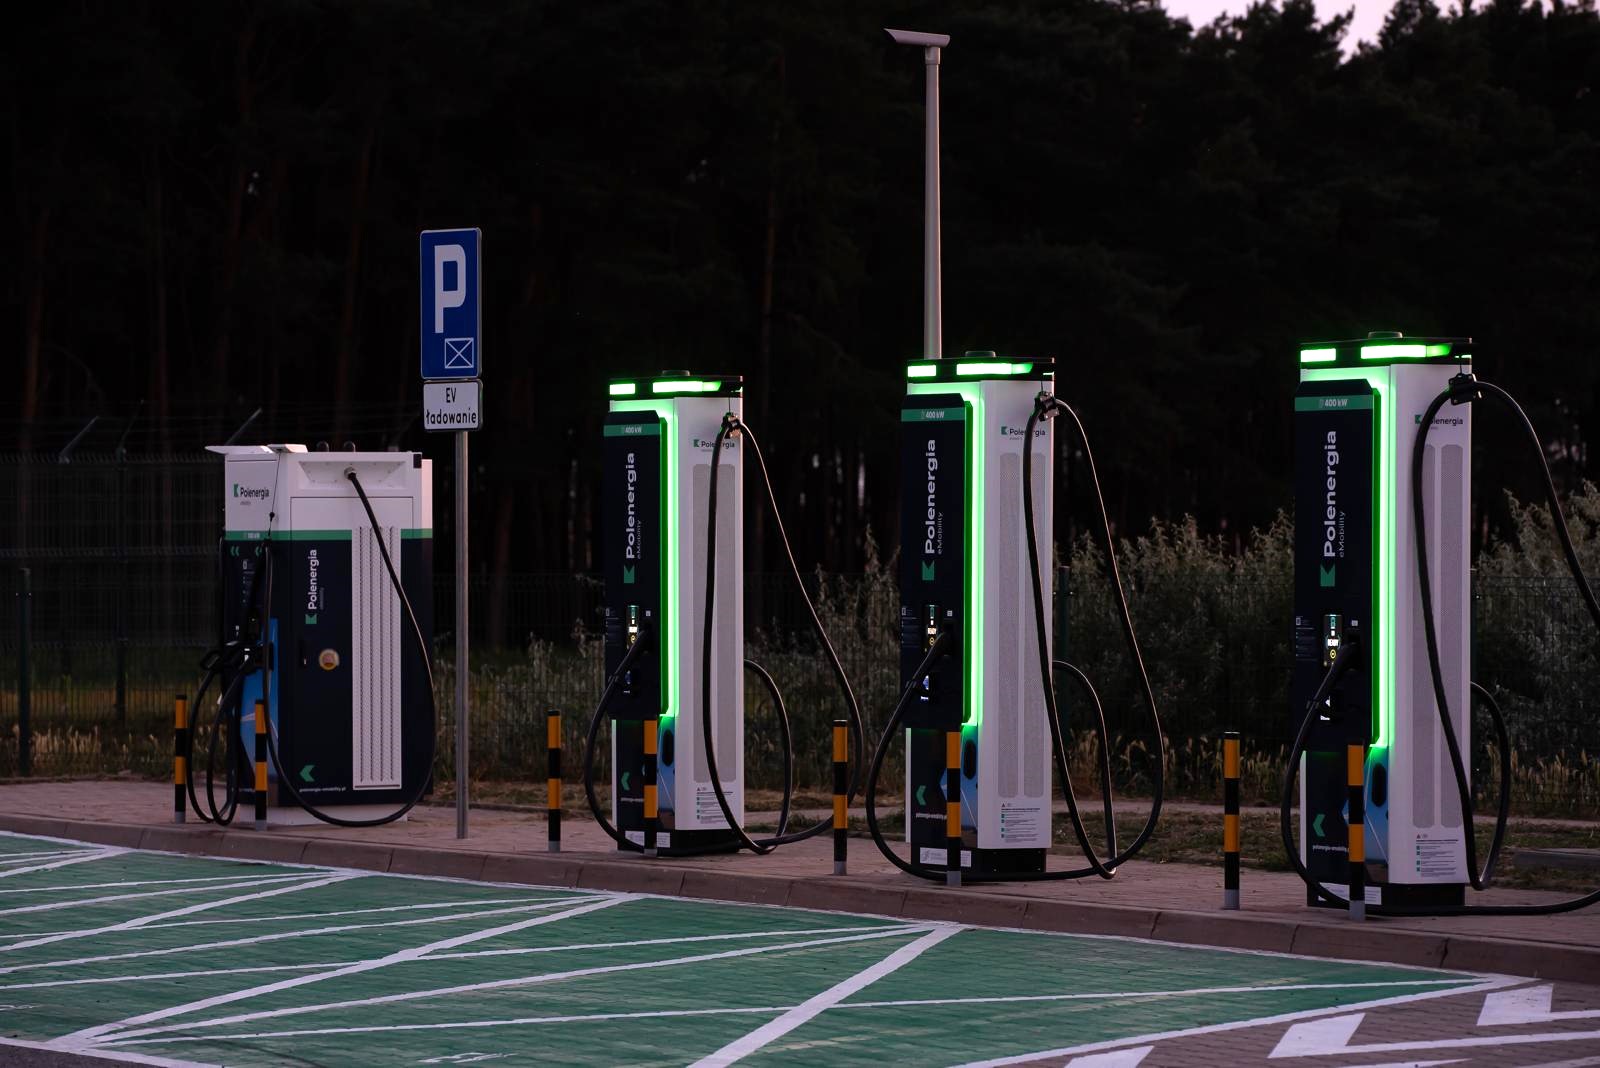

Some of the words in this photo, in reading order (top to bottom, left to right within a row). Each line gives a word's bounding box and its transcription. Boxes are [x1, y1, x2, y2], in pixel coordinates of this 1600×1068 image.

[434, 244, 467, 334] P
[446, 387, 457, 403] EV
[925, 410, 936, 419] 400
[1324, 398, 1337, 407] 400
[1337, 398, 1348, 407] kW
[425, 407, 477, 426] ładowanie
[240, 486, 270, 500] Polenergia
[626, 452, 637, 559] Polenergia
[925, 439, 938, 554] Polenergia
[1324, 430, 1339, 557] Polenergia
[308, 548, 320, 610] Polenergia
